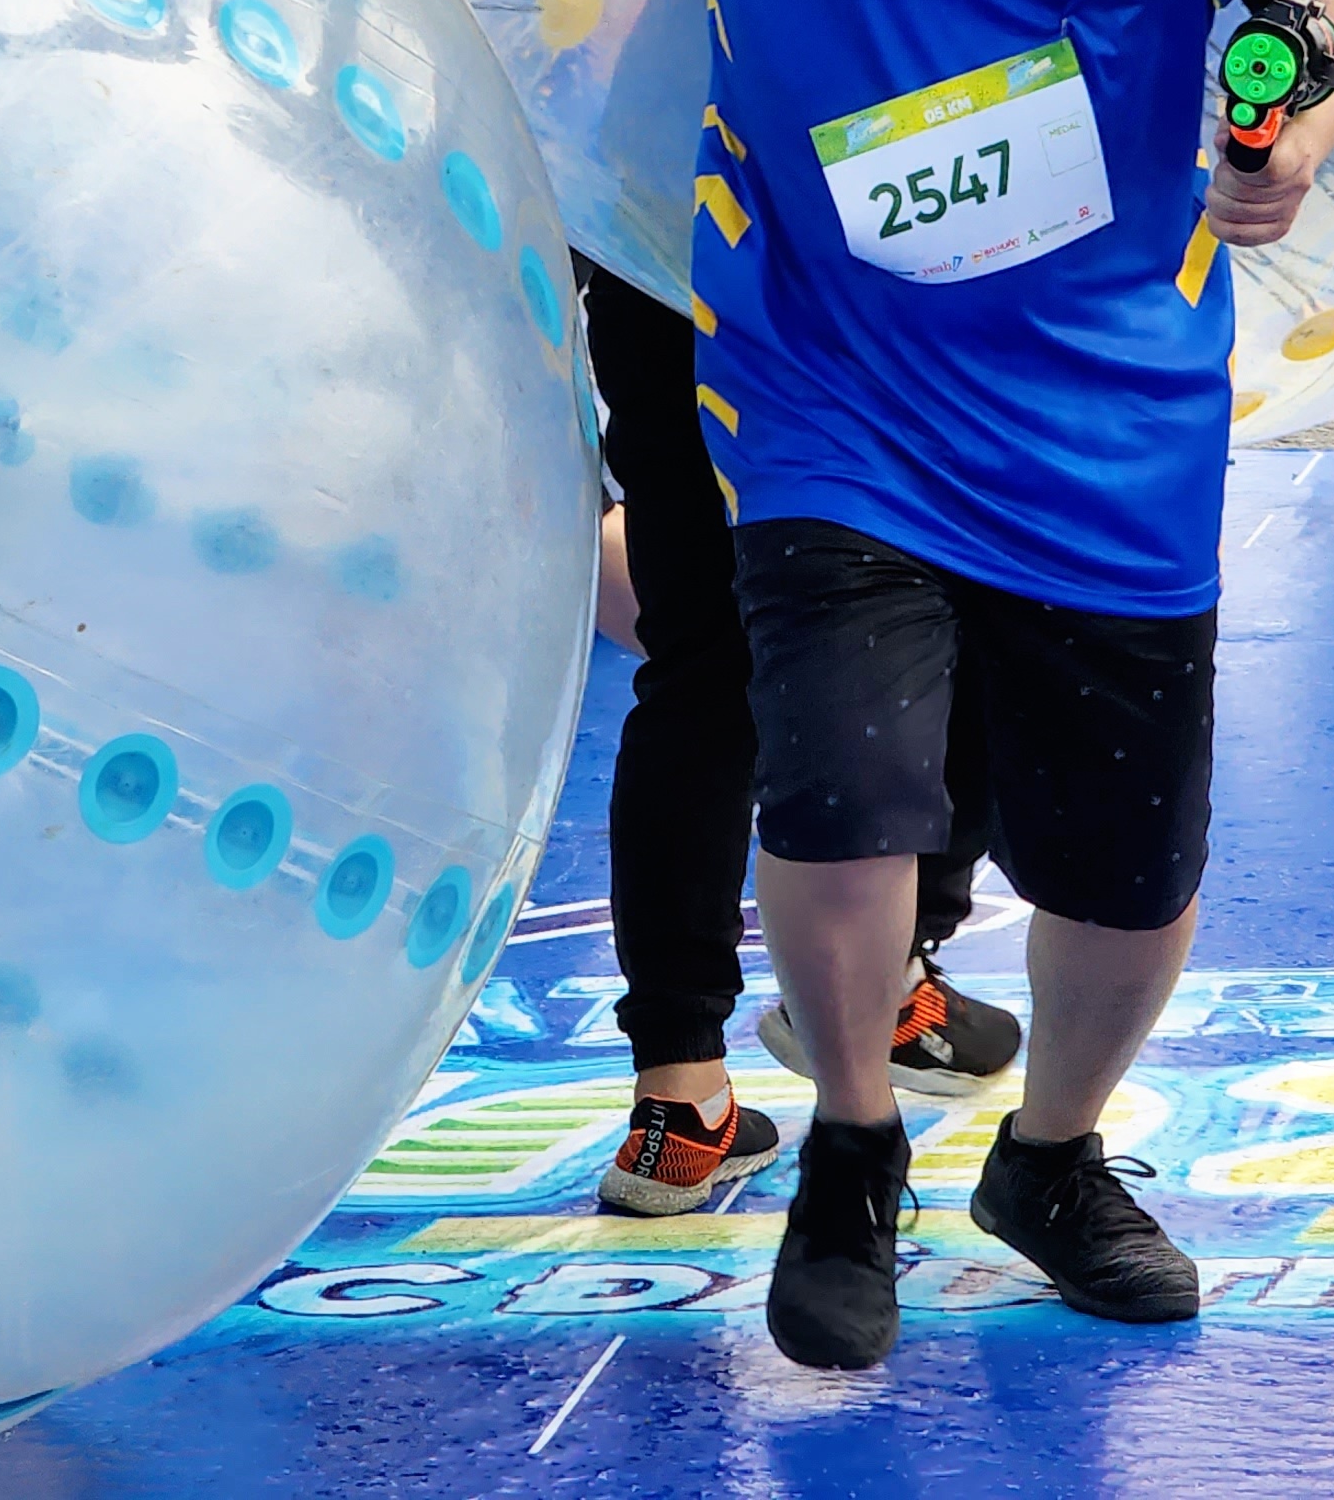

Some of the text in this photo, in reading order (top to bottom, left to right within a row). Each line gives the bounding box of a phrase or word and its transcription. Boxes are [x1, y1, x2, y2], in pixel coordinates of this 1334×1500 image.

[923, 96, 974, 125] 05 KM
[1047, 119, 1083, 138] MEDAL
[867, 139, 1012, 241] 2547
